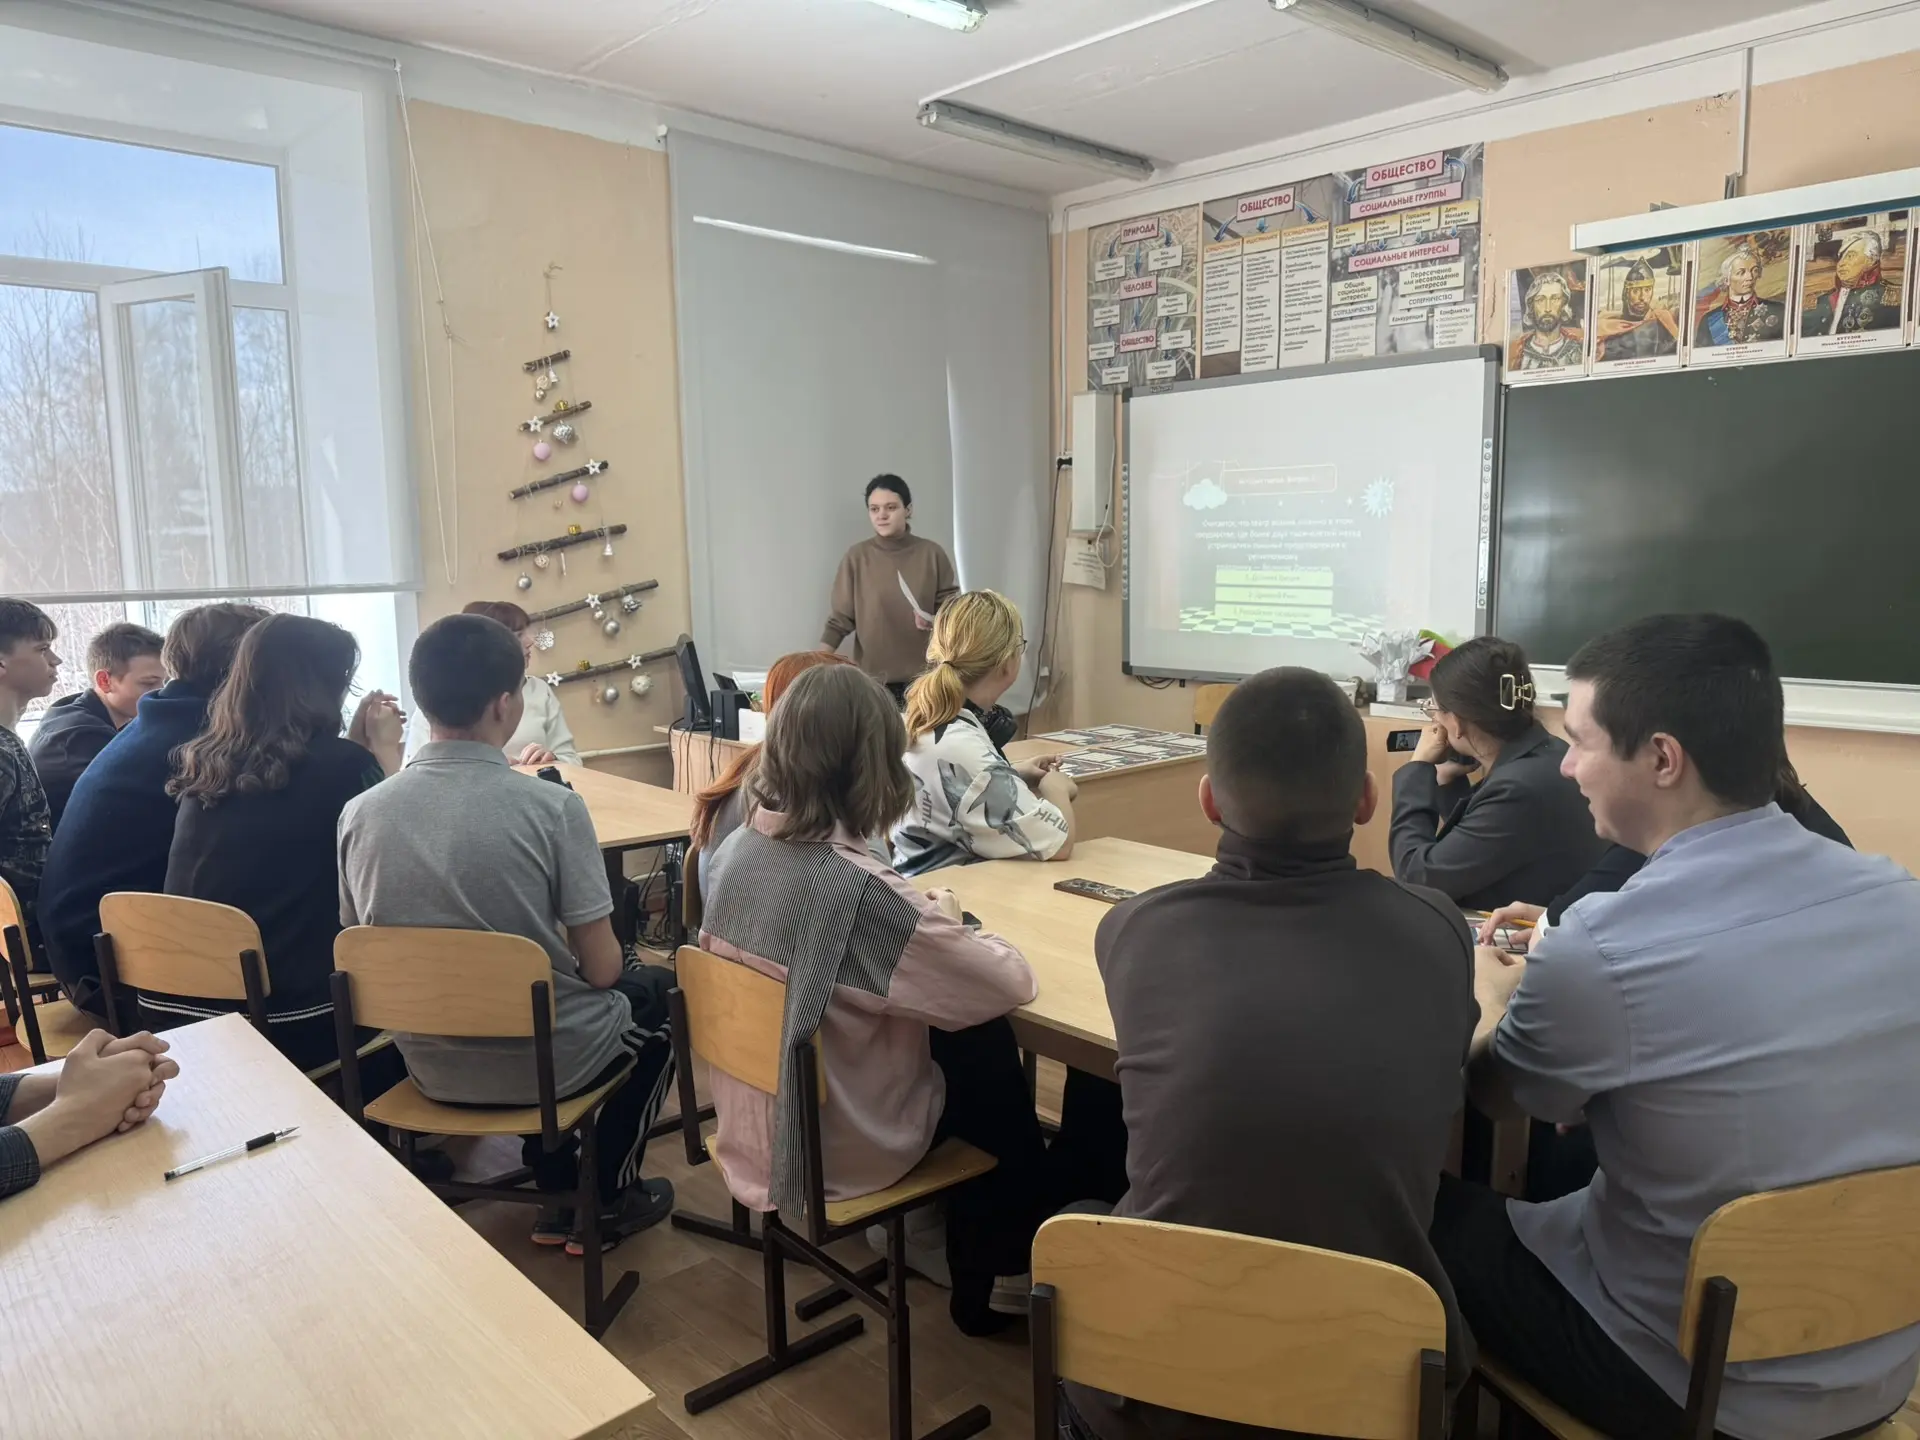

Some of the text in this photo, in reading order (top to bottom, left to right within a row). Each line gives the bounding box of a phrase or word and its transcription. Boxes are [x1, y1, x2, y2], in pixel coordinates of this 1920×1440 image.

[1371, 159, 1436, 181] ОБЩЕСТВО
[1240, 194, 1291, 213] ОБЩЕСТВО
[1360, 188, 1447, 213] СОЦИАЛЬНЫЕ ГРУППЫ
[1123, 223, 1156, 237] ПРИРОДА
[1354, 244, 1449, 268] СОЦИАЛЬНЫЕ ИНТЕРЕСЫ
[1123, 280, 1153, 293] ЧЕЛОВЕК
[1121, 335, 1155, 347] ОБЩЕСТВО
